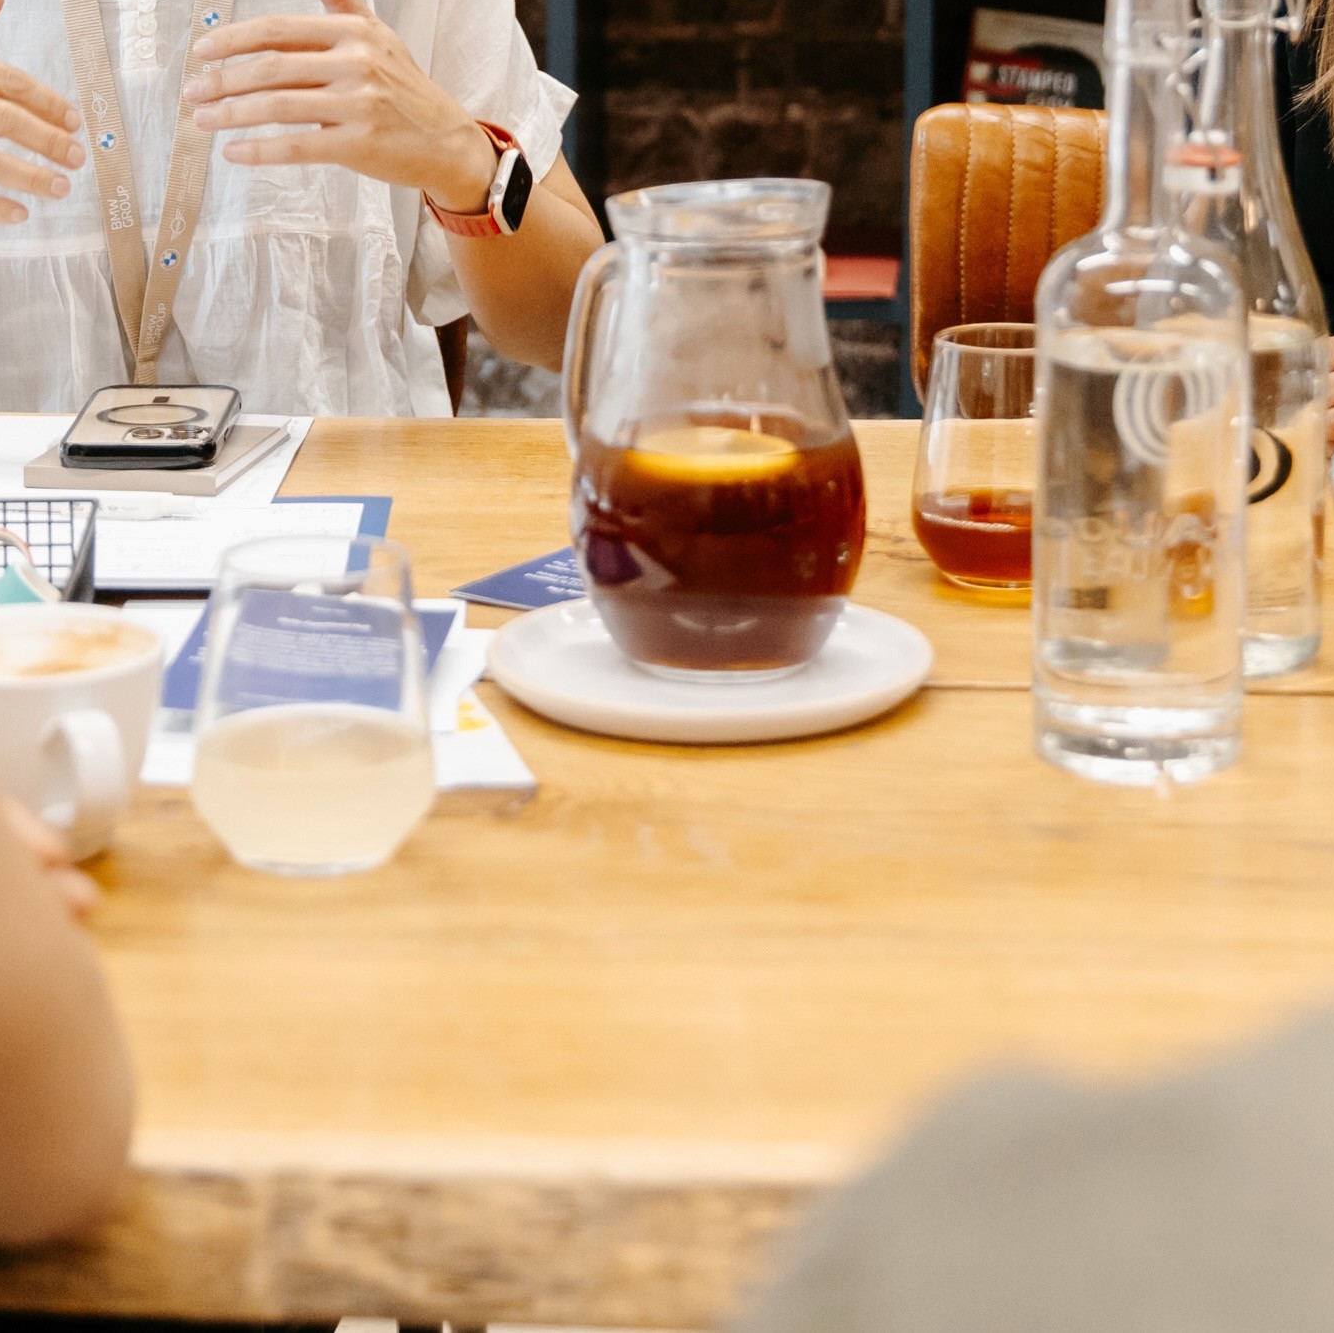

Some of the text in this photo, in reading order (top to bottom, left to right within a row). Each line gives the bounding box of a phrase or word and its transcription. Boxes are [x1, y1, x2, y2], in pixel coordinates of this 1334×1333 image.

[998, 66, 1078, 94] STAMPED
[107, 198, 123, 231] BMW
[116, 185, 134, 228] GROUP
[143, 314, 157, 345] BMW
[152, 302, 166, 344] GROUP
